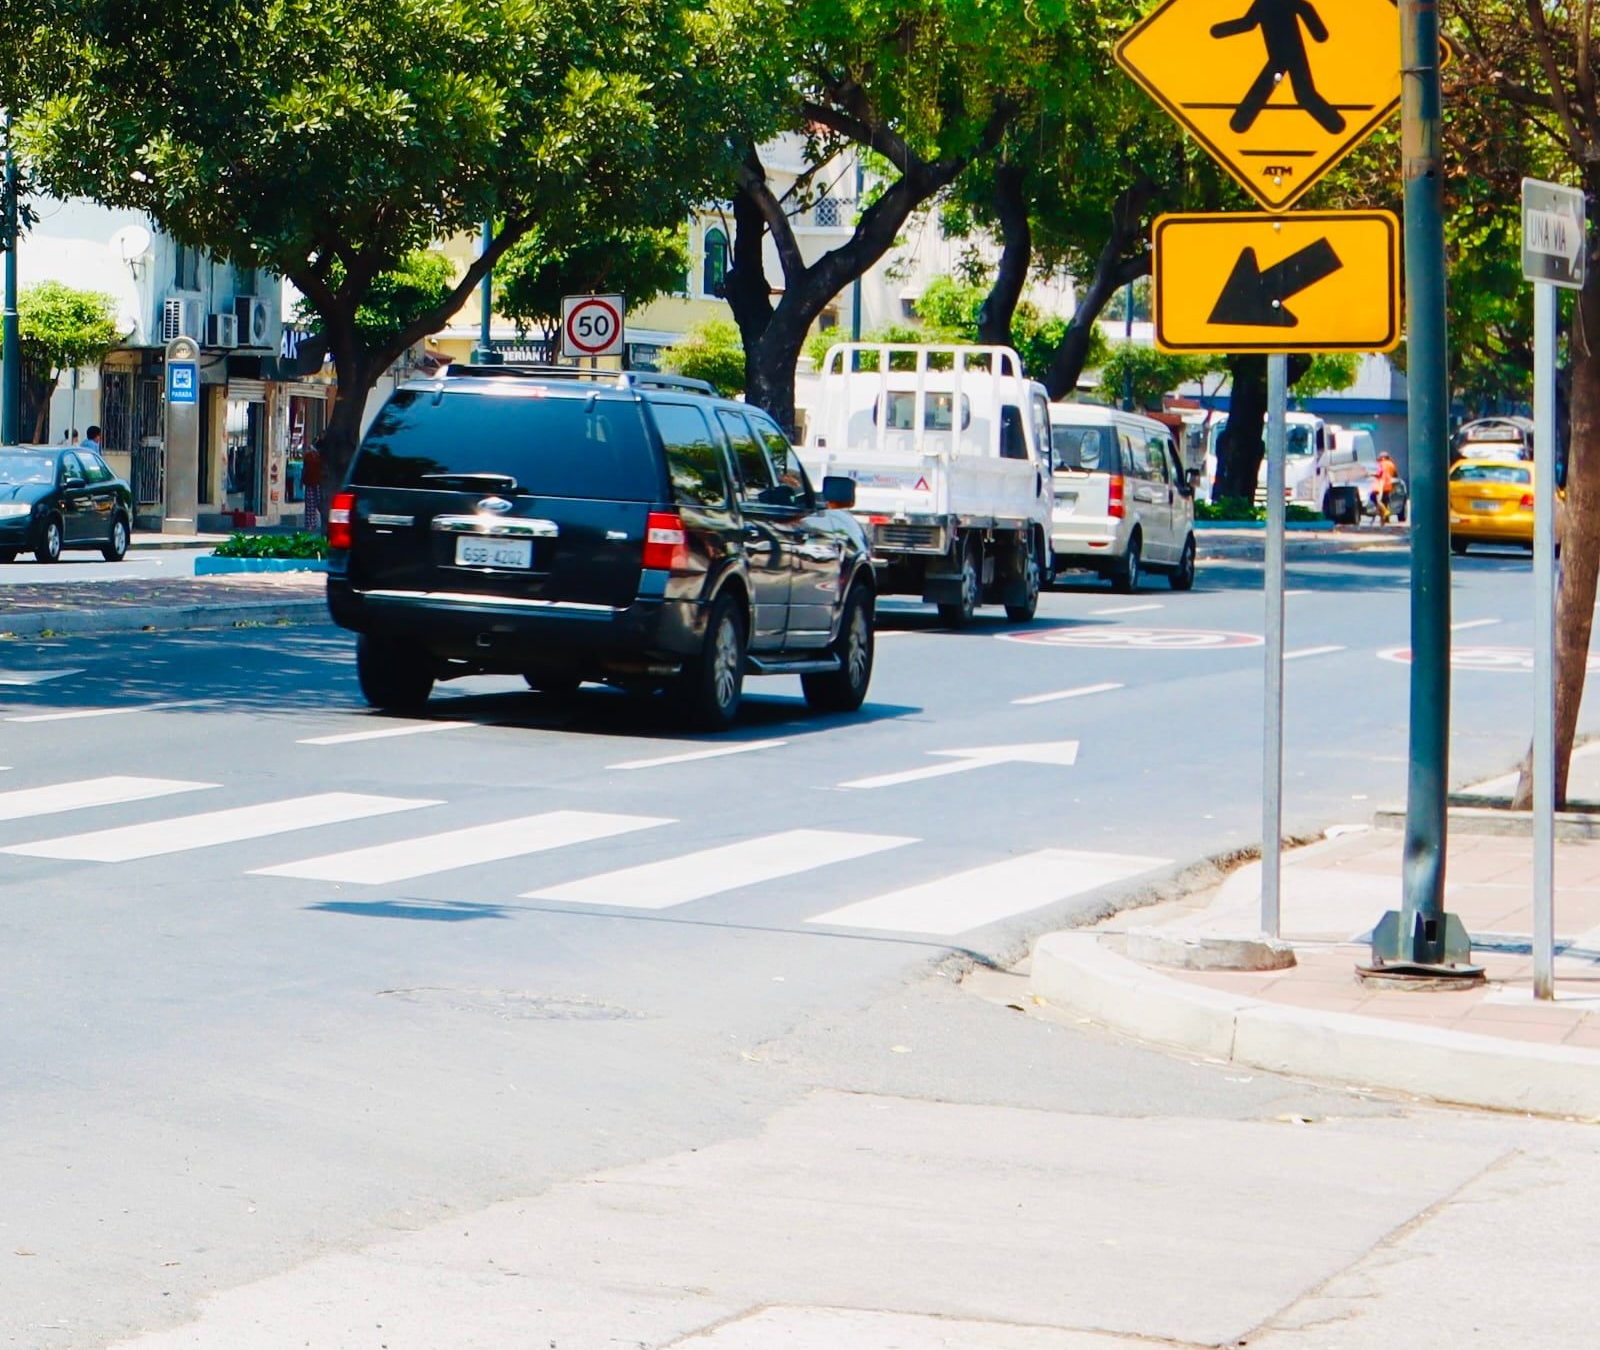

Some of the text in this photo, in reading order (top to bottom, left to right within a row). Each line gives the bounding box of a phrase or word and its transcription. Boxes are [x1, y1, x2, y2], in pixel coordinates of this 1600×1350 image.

[1262, 165, 1293, 176] ATM
[1530, 211, 1567, 251] UNA VIA
[579, 316, 609, 337] 50
